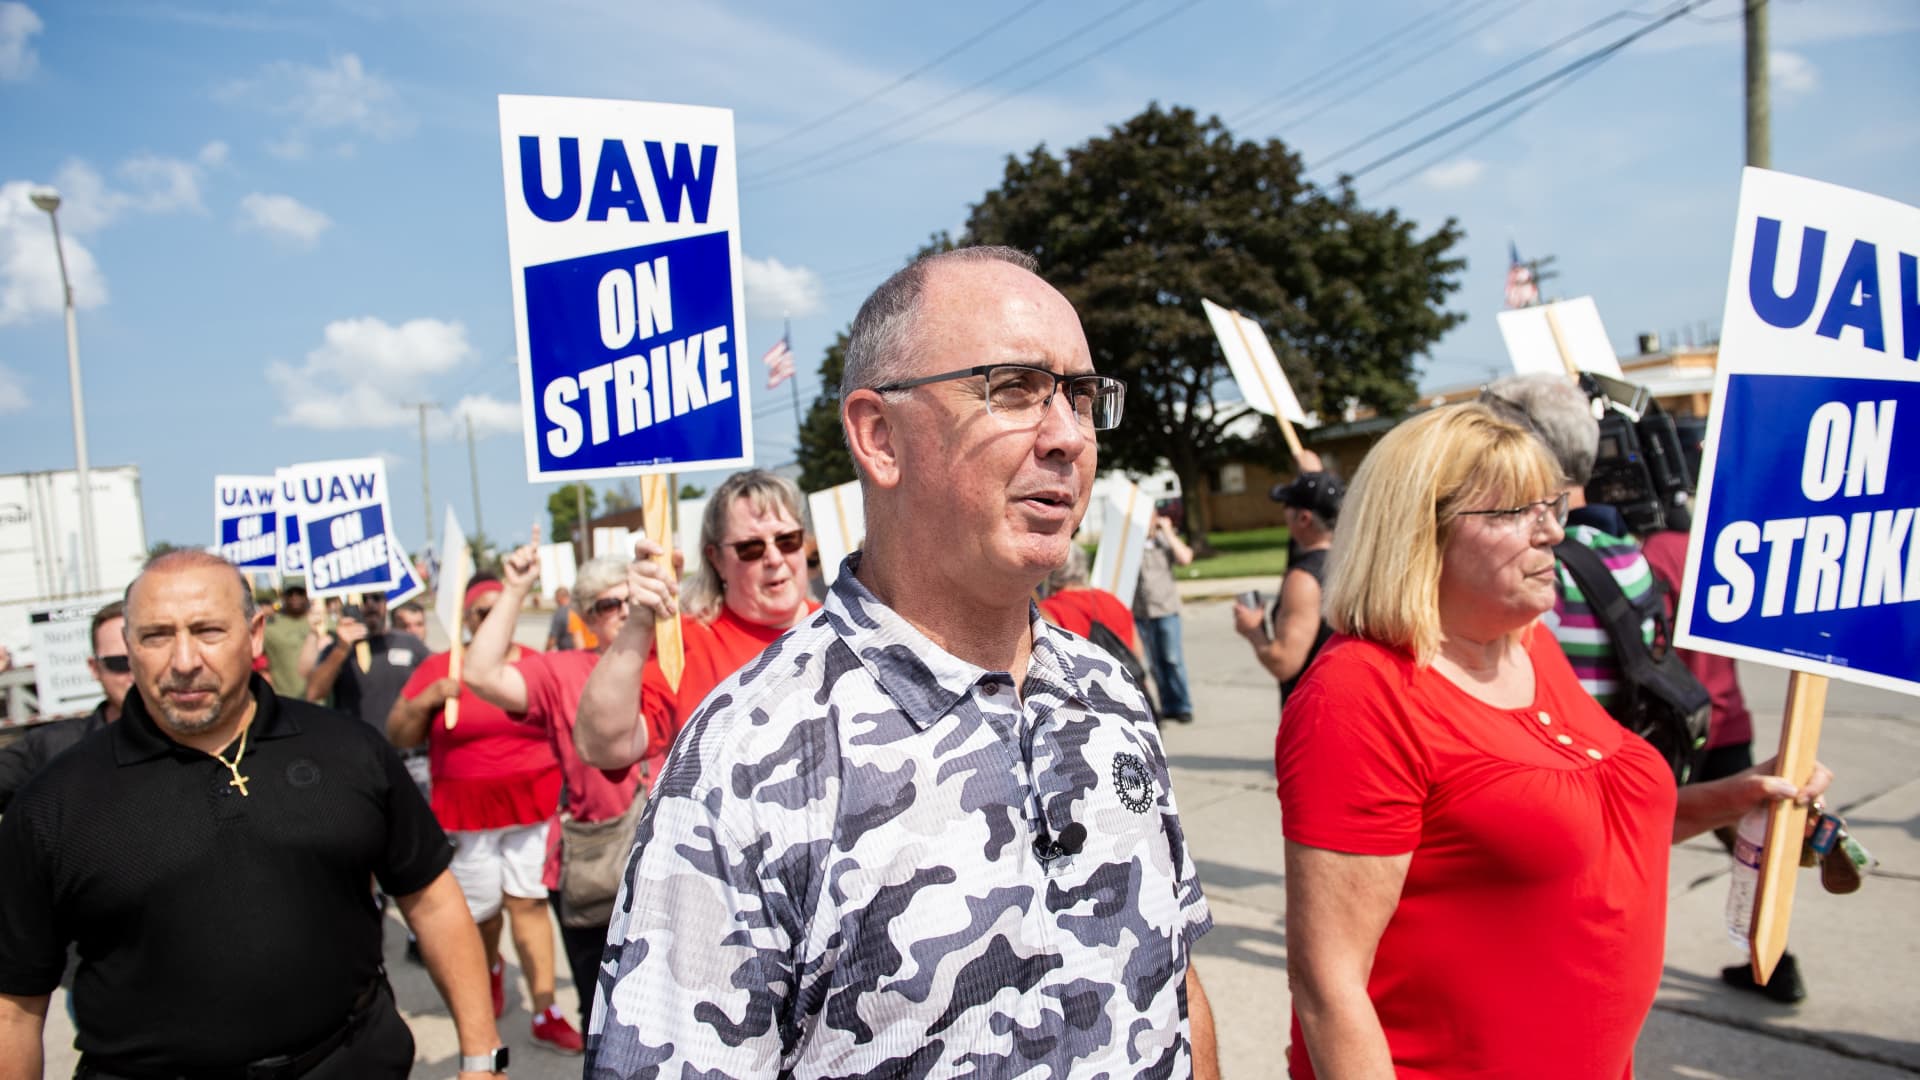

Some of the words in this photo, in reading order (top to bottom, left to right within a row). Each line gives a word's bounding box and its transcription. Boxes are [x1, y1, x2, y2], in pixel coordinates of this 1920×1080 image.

[519, 136, 718, 223] UAW
[598, 256, 673, 350] ON
[543, 325, 732, 458] STRIKE
[1801, 399, 1897, 502] ON
[222, 488, 275, 506] UAW
[302, 473, 375, 504] UAW
[237, 515, 263, 539] ON
[330, 510, 364, 549] ON
[312, 533, 387, 589] STRIKE
[1123, 775, 1142, 790] UAW
